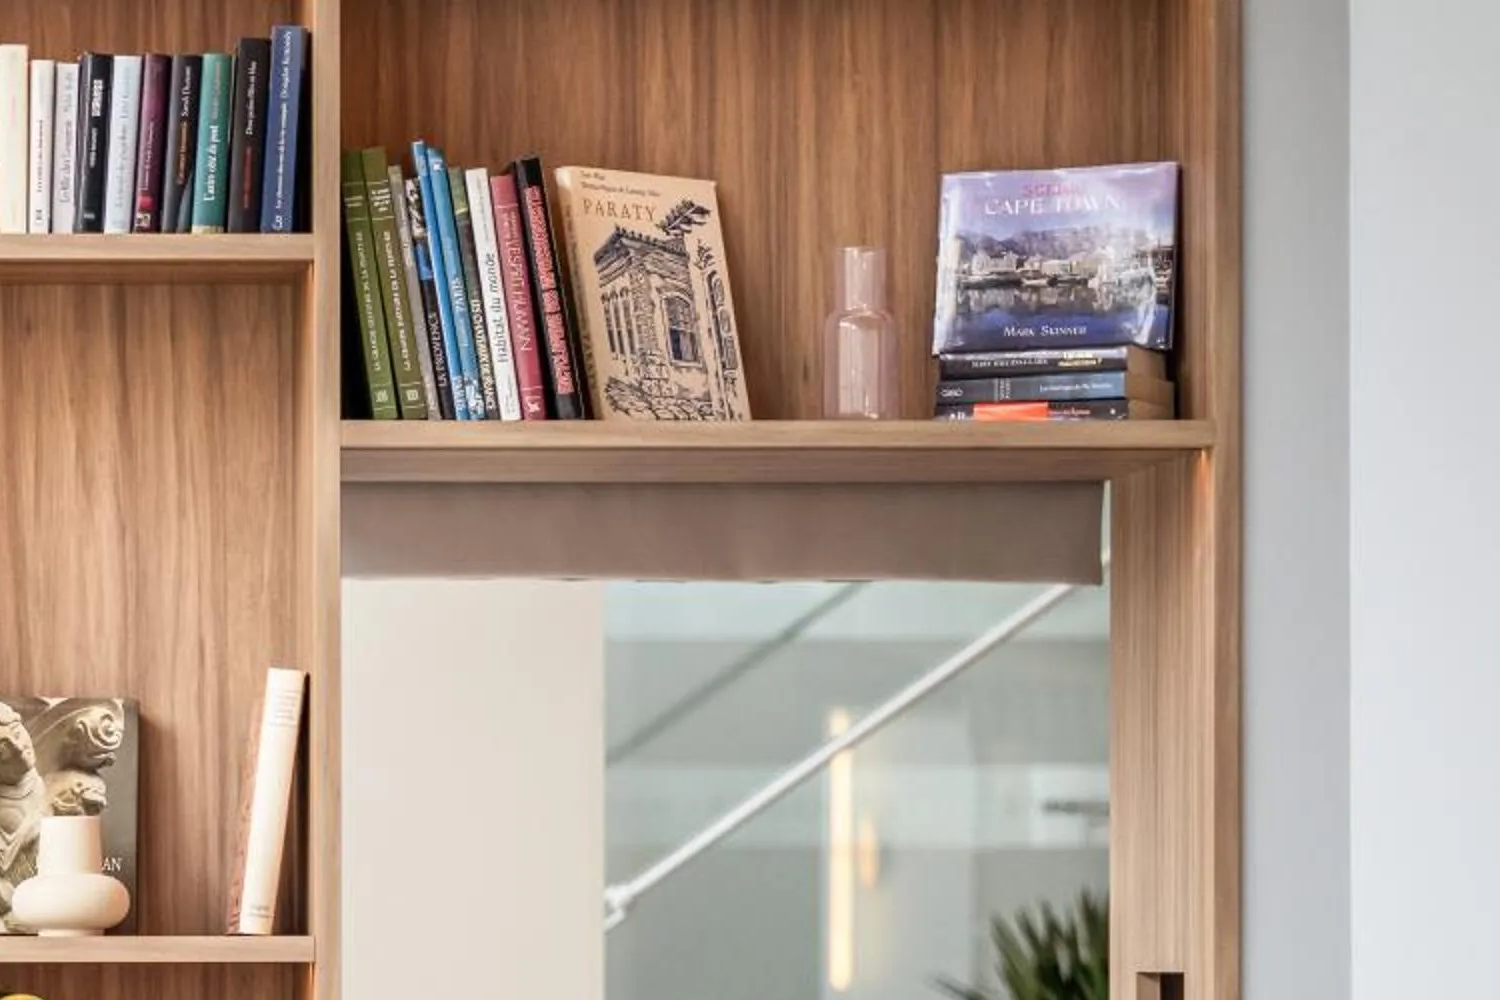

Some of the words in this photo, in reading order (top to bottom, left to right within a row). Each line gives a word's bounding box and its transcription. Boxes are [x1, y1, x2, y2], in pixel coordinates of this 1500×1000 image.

[582, 199, 656, 221] PARATY
[984, 199, 1044, 216] CAPE
[1056, 194, 1120, 213] TOWN
[483, 252, 498, 293] monde
[488, 297, 501, 313] du
[492, 316, 508, 363] Habitat
[100, 857, 122, 872] AN
